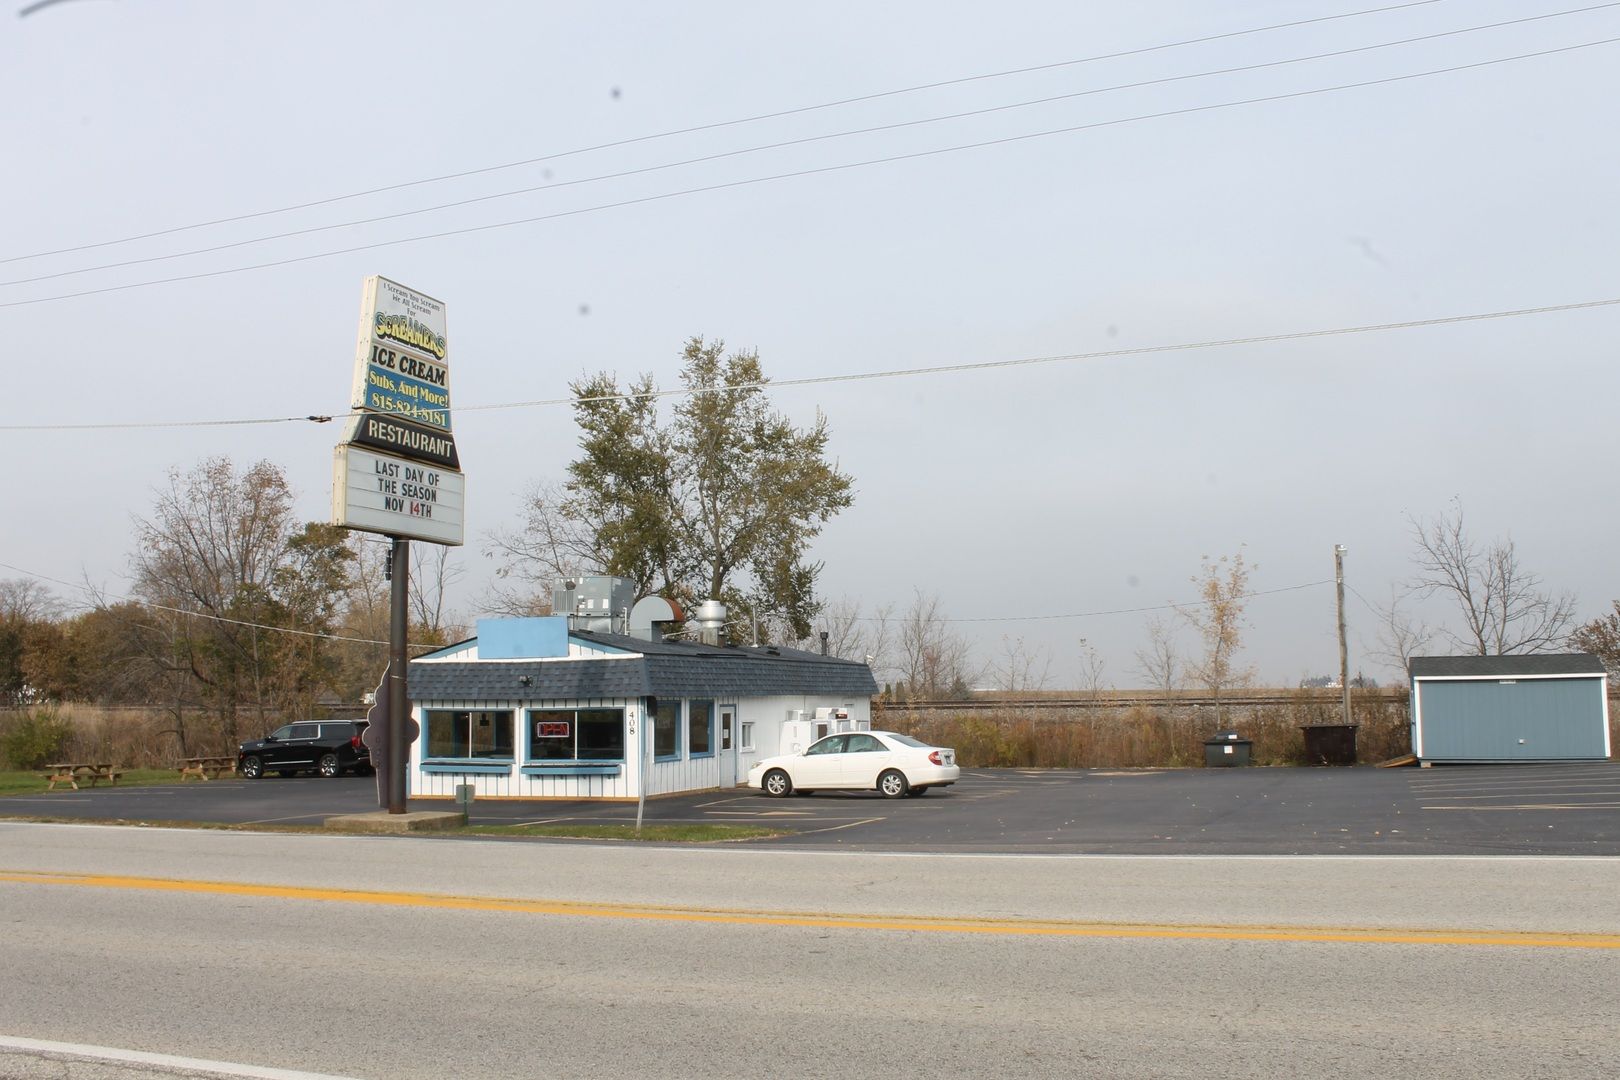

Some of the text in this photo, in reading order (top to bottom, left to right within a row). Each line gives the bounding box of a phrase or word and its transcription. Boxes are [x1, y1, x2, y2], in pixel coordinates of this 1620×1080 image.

[387, 283, 408, 298] Scream
[409, 293, 420, 303] You
[420, 298, 440, 311] Scream
[392, 293, 432, 315] We All Scream
[407, 307, 417, 317] For
[372, 345, 446, 386] ICE CREAM
[369, 370, 448, 407] Subs, And More!
[371, 392, 447, 426] 815-824-8181
[368, 419, 453, 458] RESTAURANT
[375, 460, 440, 486] LAST DAY OF
[378, 477, 437, 502] THE SEASON
[385, 496, 432, 518] NOV 14TH
